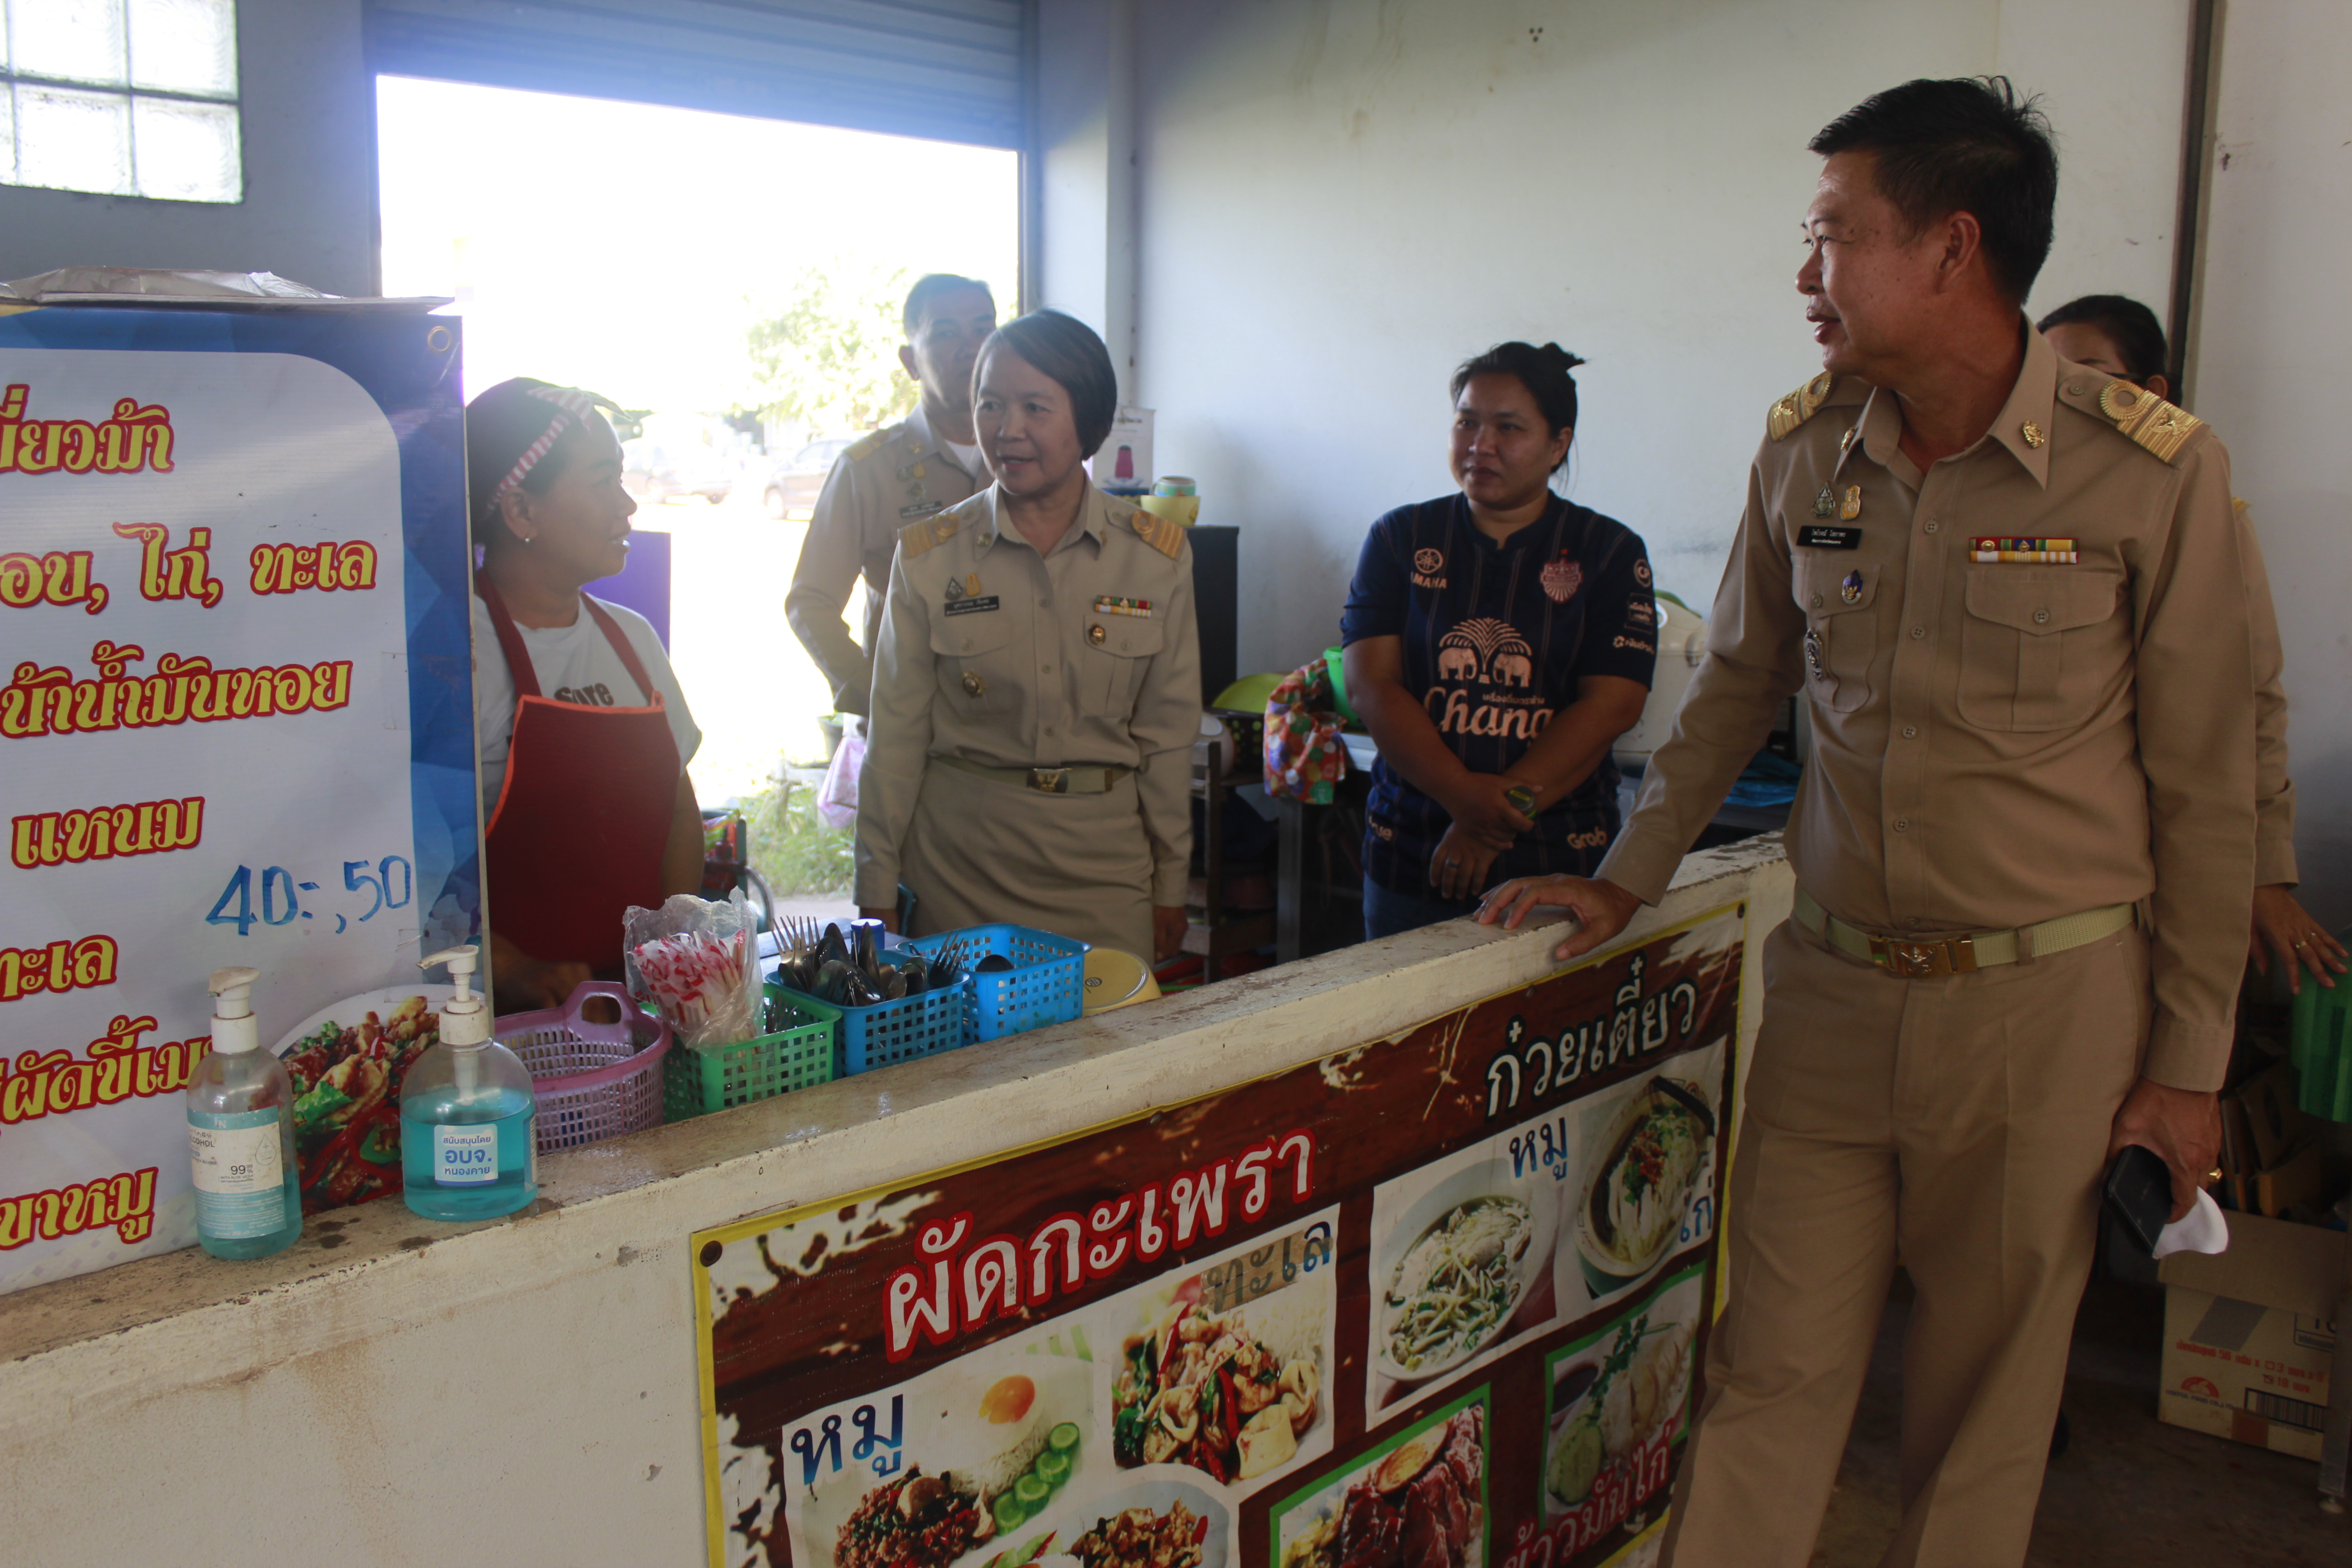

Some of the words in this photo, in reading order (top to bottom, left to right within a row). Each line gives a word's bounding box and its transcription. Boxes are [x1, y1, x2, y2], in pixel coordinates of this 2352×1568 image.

[250, 540, 377, 595] ทะเล
[1410, 571, 1449, 589] MAHA
[11, 796, 205, 869] แหนม
[1566, 825, 1608, 850] Grab
[1484, 949, 1700, 1123] ก๋วยเตี๋ยว
[0, 1014, 212, 1125] ผัดขี้เม
[190, 1135, 216, 1147] LCOHOL
[443, 1135, 491, 1147] สนับสนุนโดย
[445, 1149, 492, 1164] อบจ.
[1509, 1117, 1568, 1181] หมู
[445, 1166, 491, 1176] หนองคาย
[883, 1128, 1316, 1362] ผัดกะเพรา
[1206, 1220, 1332, 1315] ทะเล
[790, 1394, 904, 1486] หมู
